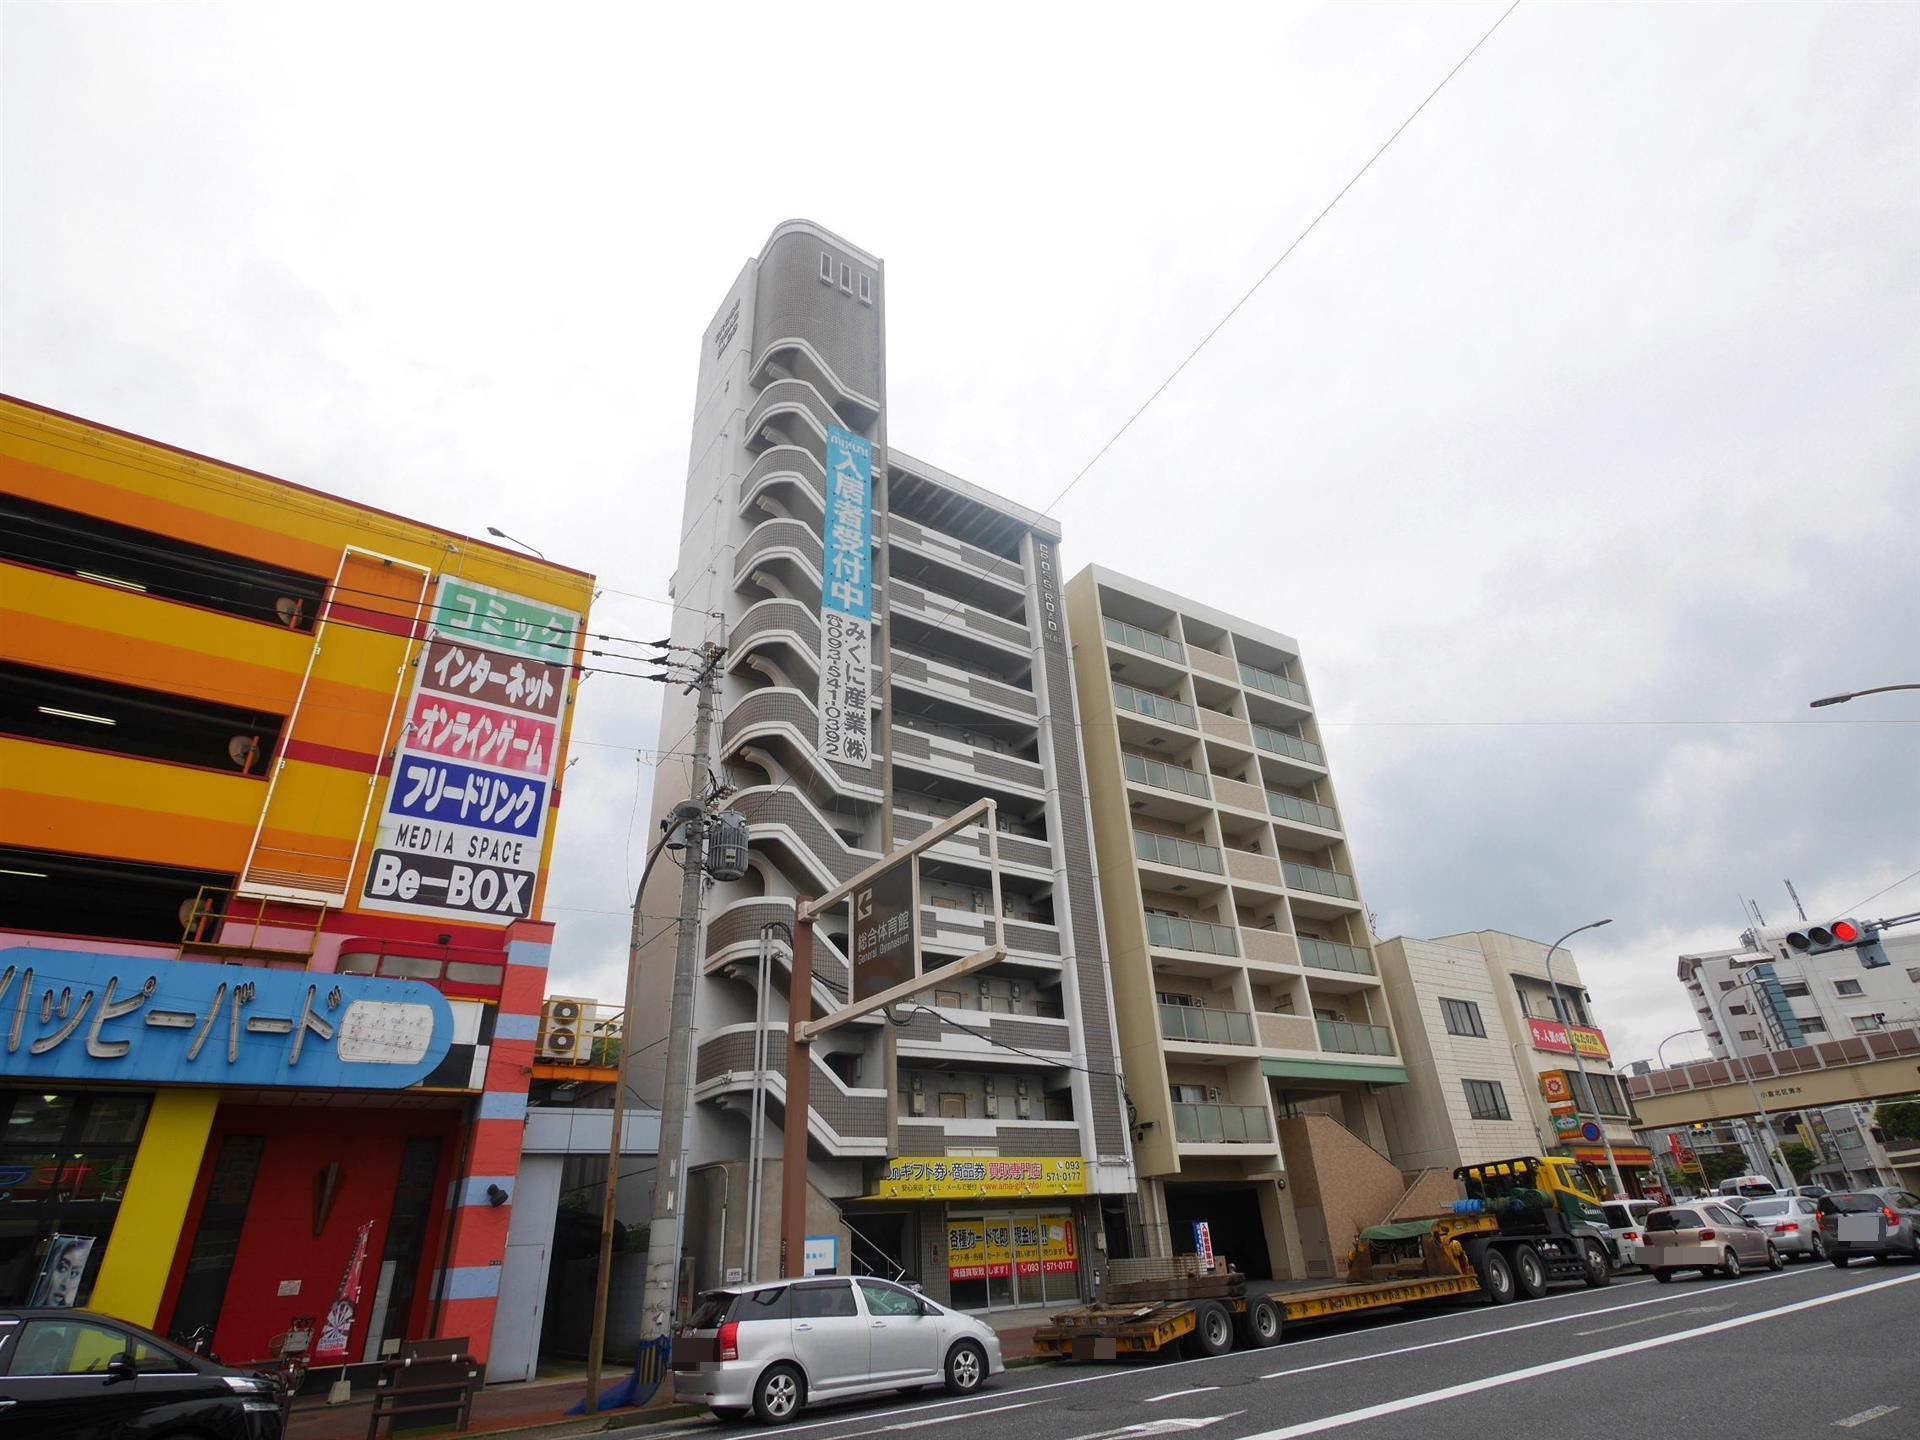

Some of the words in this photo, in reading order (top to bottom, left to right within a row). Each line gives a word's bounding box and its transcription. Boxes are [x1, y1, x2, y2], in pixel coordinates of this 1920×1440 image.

[831, 450, 865, 610] 入居者受付中
[450, 593, 567, 653] コミック
[433, 646, 554, 710] インターネット
[416, 704, 543, 770] オンラインゲーム
[402, 765, 538, 830] フリードリンク
[395, 824, 455, 855] MEDIA
[467, 834, 523, 865] SPACE
[1065, 1160, 1080, 1170] 093
